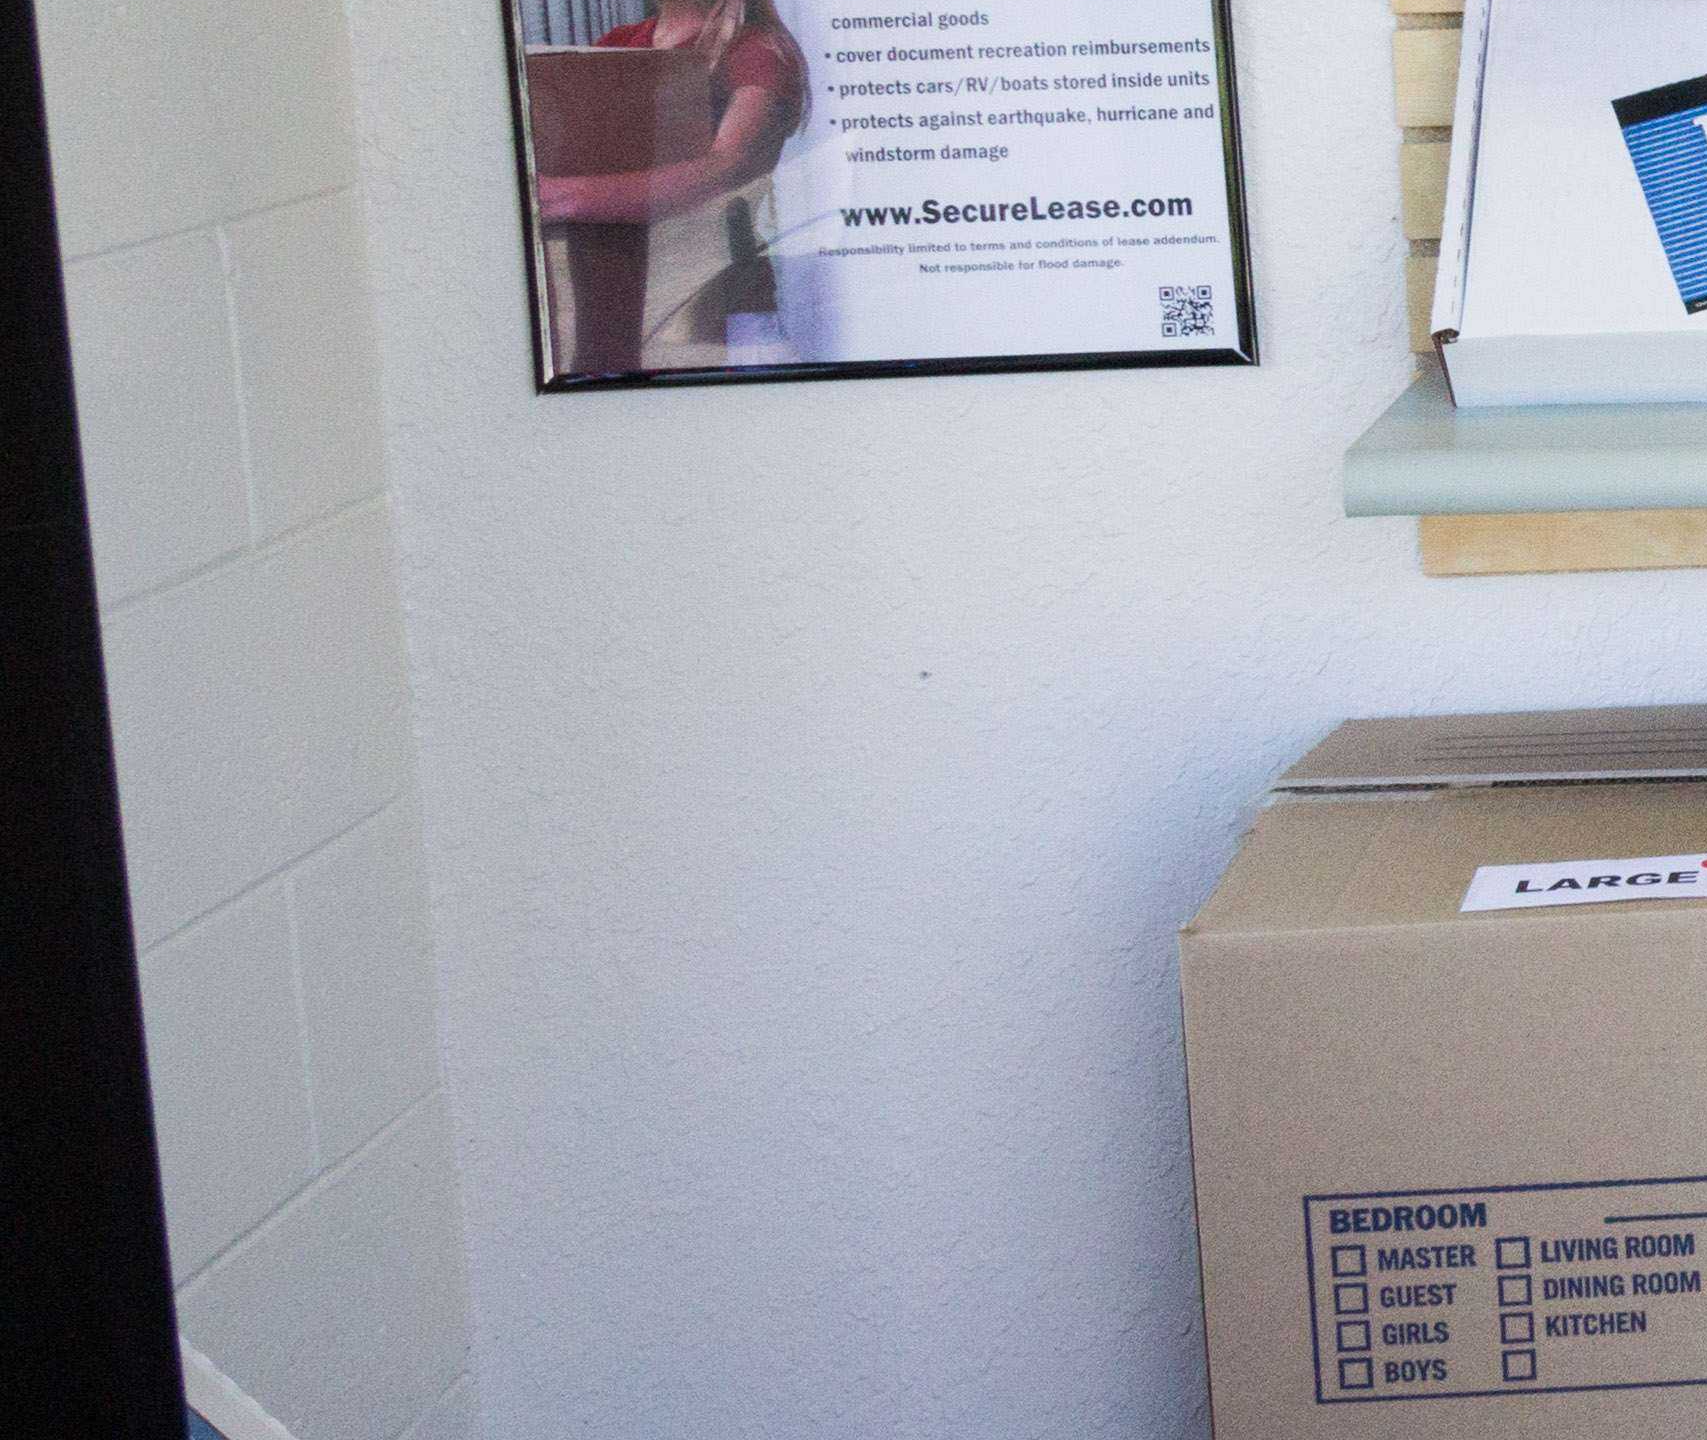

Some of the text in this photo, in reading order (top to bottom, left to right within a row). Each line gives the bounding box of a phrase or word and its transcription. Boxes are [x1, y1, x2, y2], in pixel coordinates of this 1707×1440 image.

[836, 38, 1210, 62] cover document recreation reimbursements
[847, 144, 1008, 162] windstorm damage
[841, 194, 1192, 226] www.SecureLease.com
[1515, 870, 1700, 895] LARGE
[1330, 1203, 1487, 1234] BEDROOM
[1378, 1245, 1476, 1271] MASTER
[1540, 1234, 1696, 1263] LIVING ROOM
[1379, 1283, 1457, 1309] GUEST
[1542, 1271, 1701, 1300] DINING ROOM
[1545, 1311, 1647, 1337] KITCHEN
